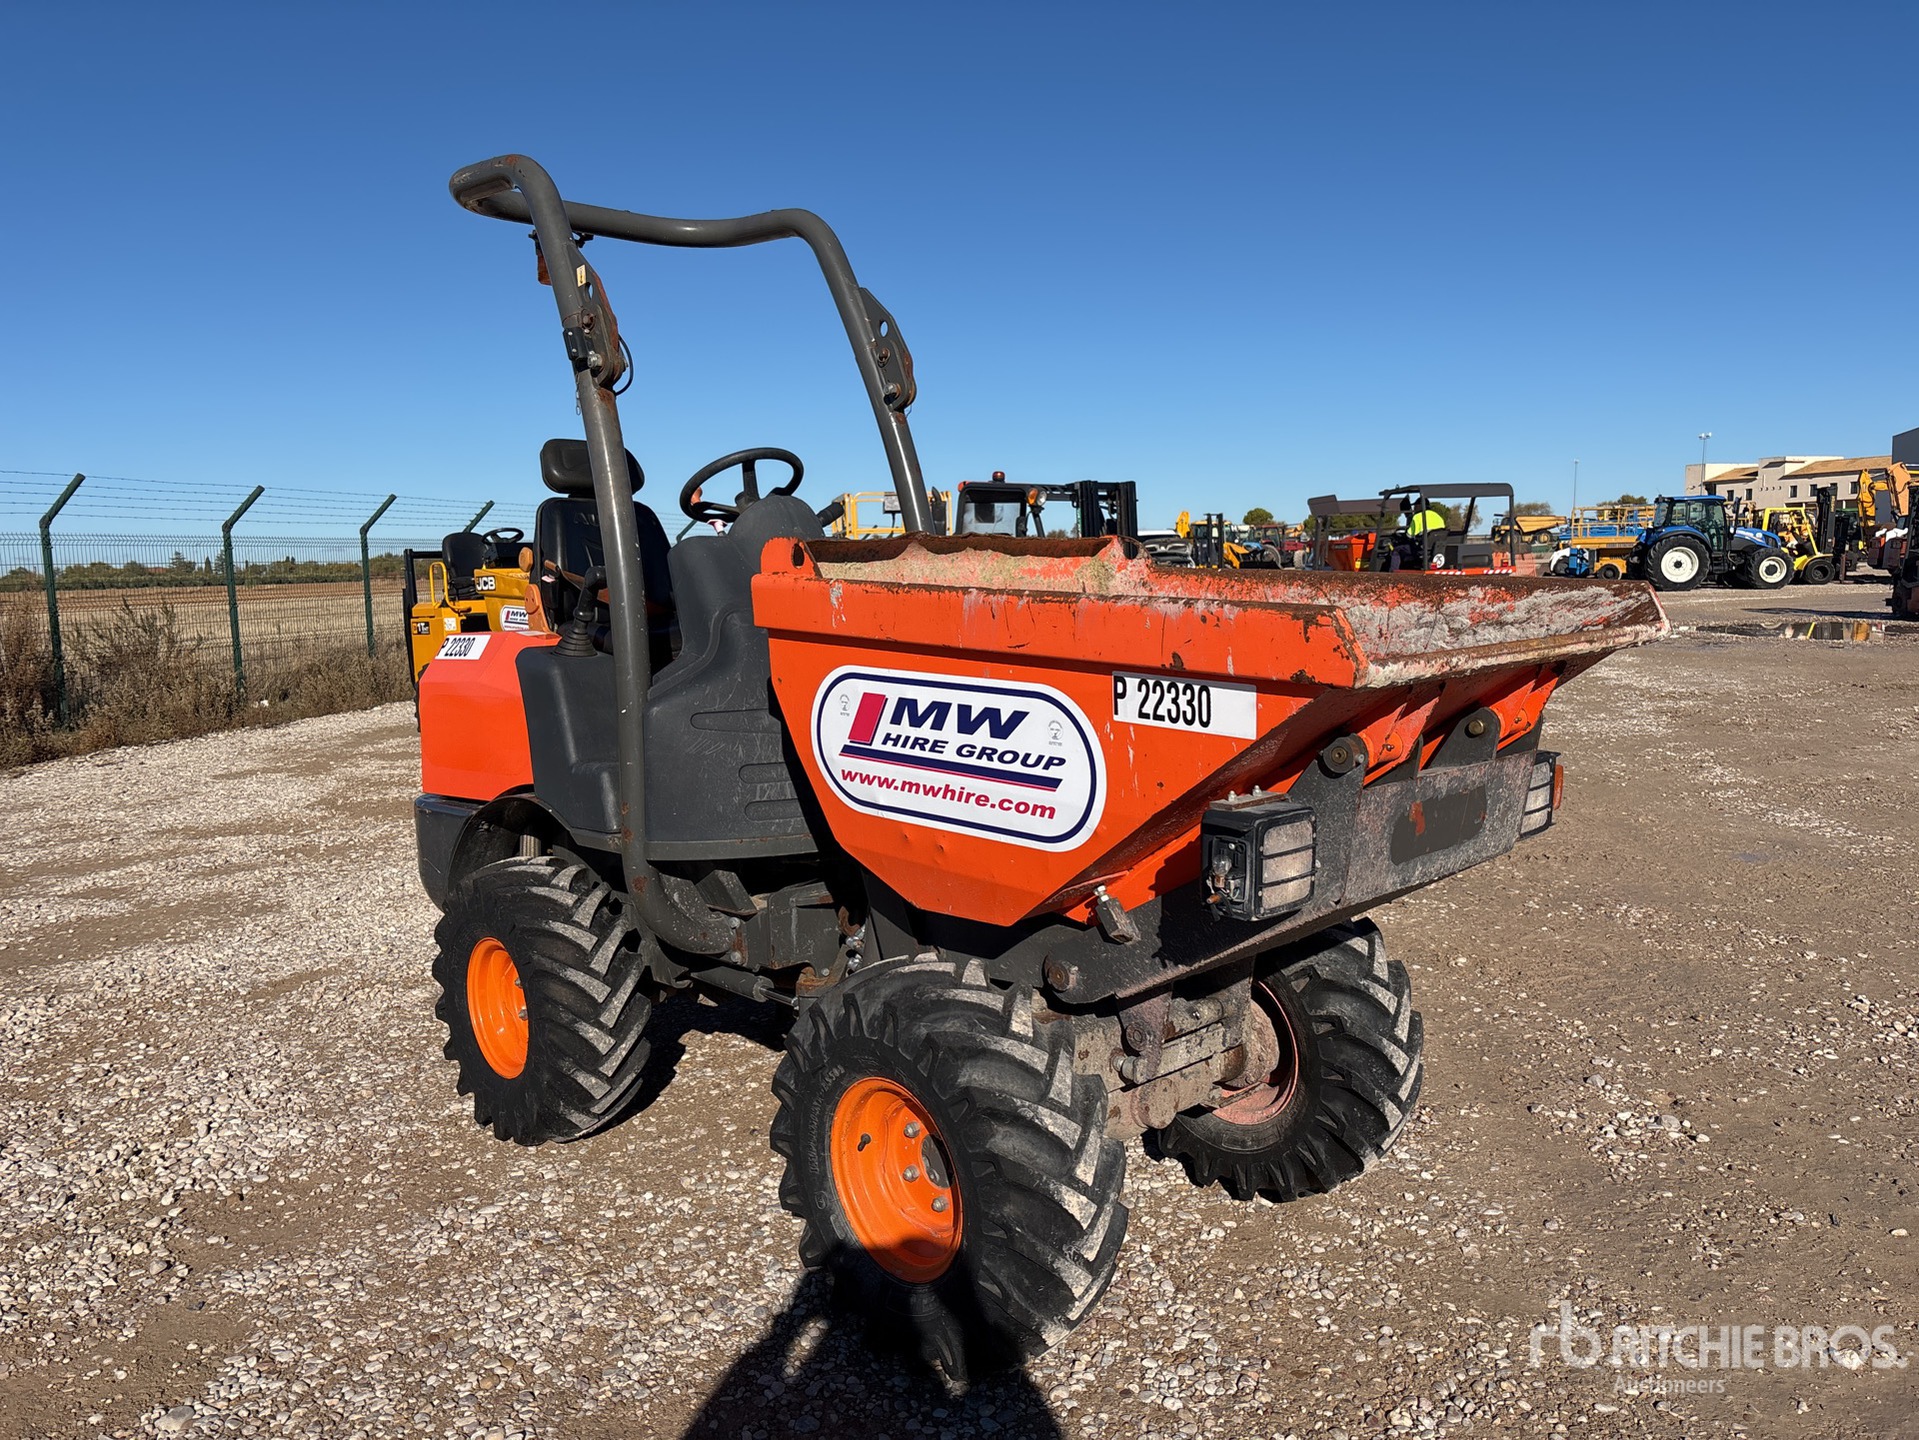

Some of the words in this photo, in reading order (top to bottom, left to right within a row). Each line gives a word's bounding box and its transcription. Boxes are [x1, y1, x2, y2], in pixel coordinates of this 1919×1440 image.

[476, 576, 496, 591] JCB
[510, 610, 528, 618] MW
[437, 637, 449, 656] P
[445, 637, 475, 657] 22330
[889, 696, 1030, 740] MW
[1113, 675, 1127, 716] P
[1137, 678, 1211, 728] 22330
[881, 732, 949, 755] HIRE
[955, 743, 1066, 771] GROUP
[841, 769, 1057, 820] www.mwhire.com
